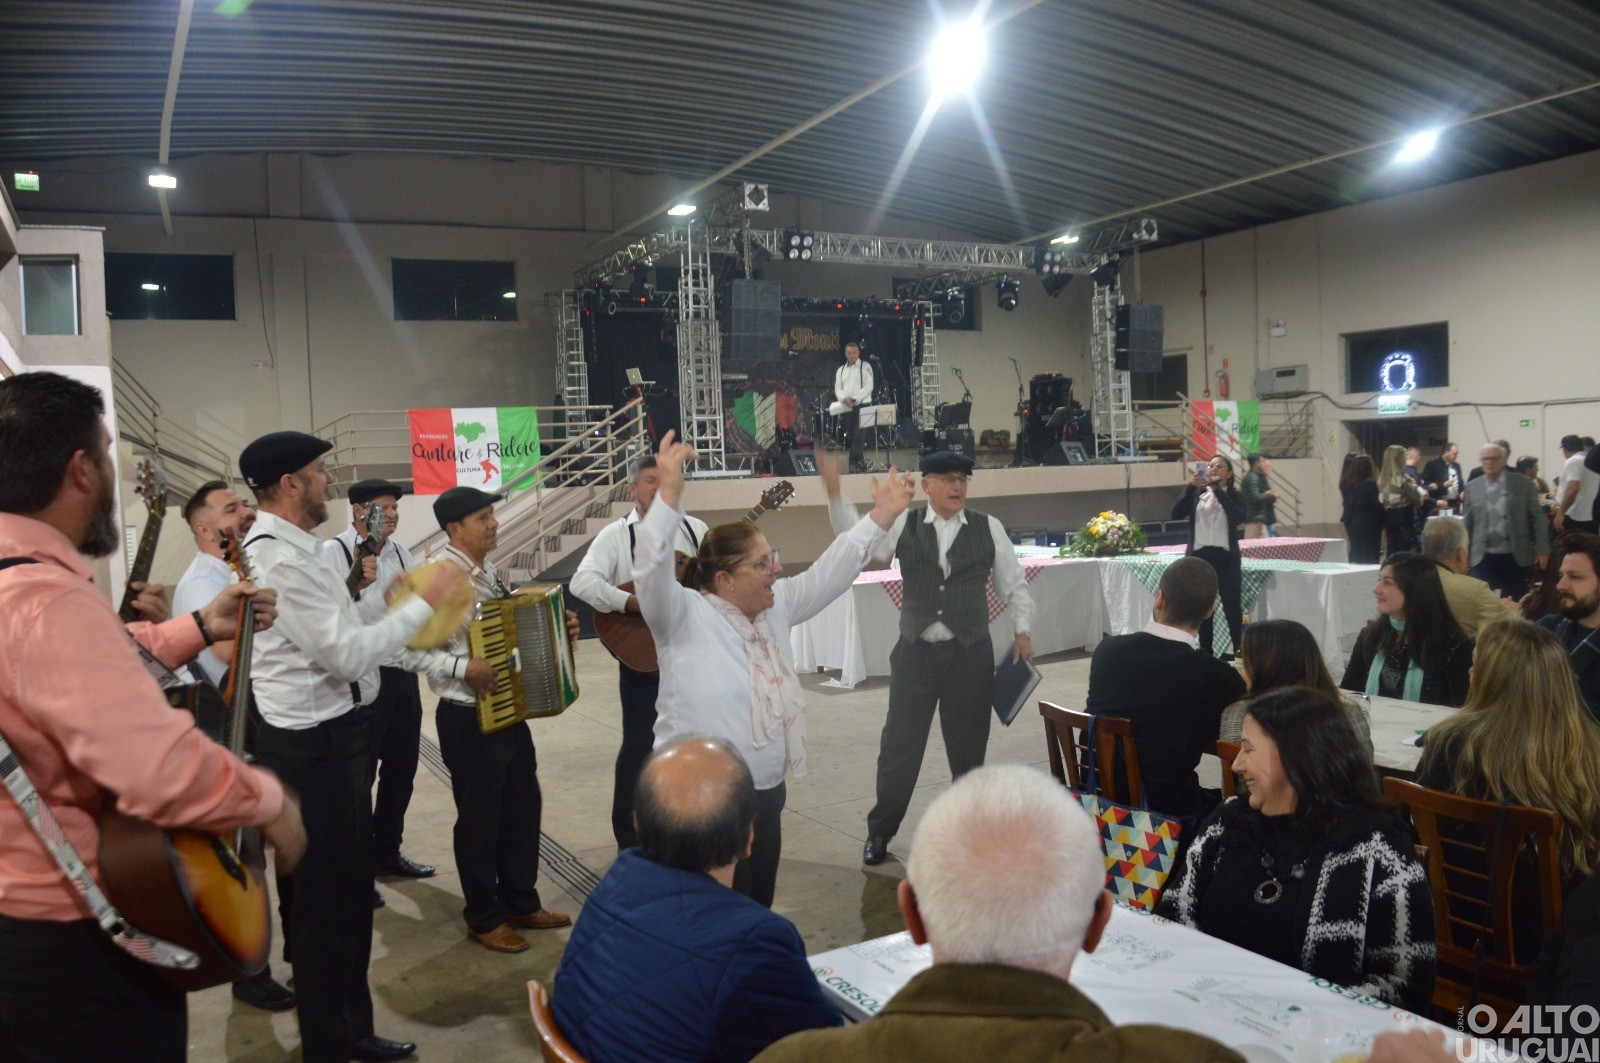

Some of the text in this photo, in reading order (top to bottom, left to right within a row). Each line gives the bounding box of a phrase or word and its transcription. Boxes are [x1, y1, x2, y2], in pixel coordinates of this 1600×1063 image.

[412, 442, 474, 463] Cantare
[487, 435, 536, 459] Ridere
[826, 977, 882, 1012] CRESOL
